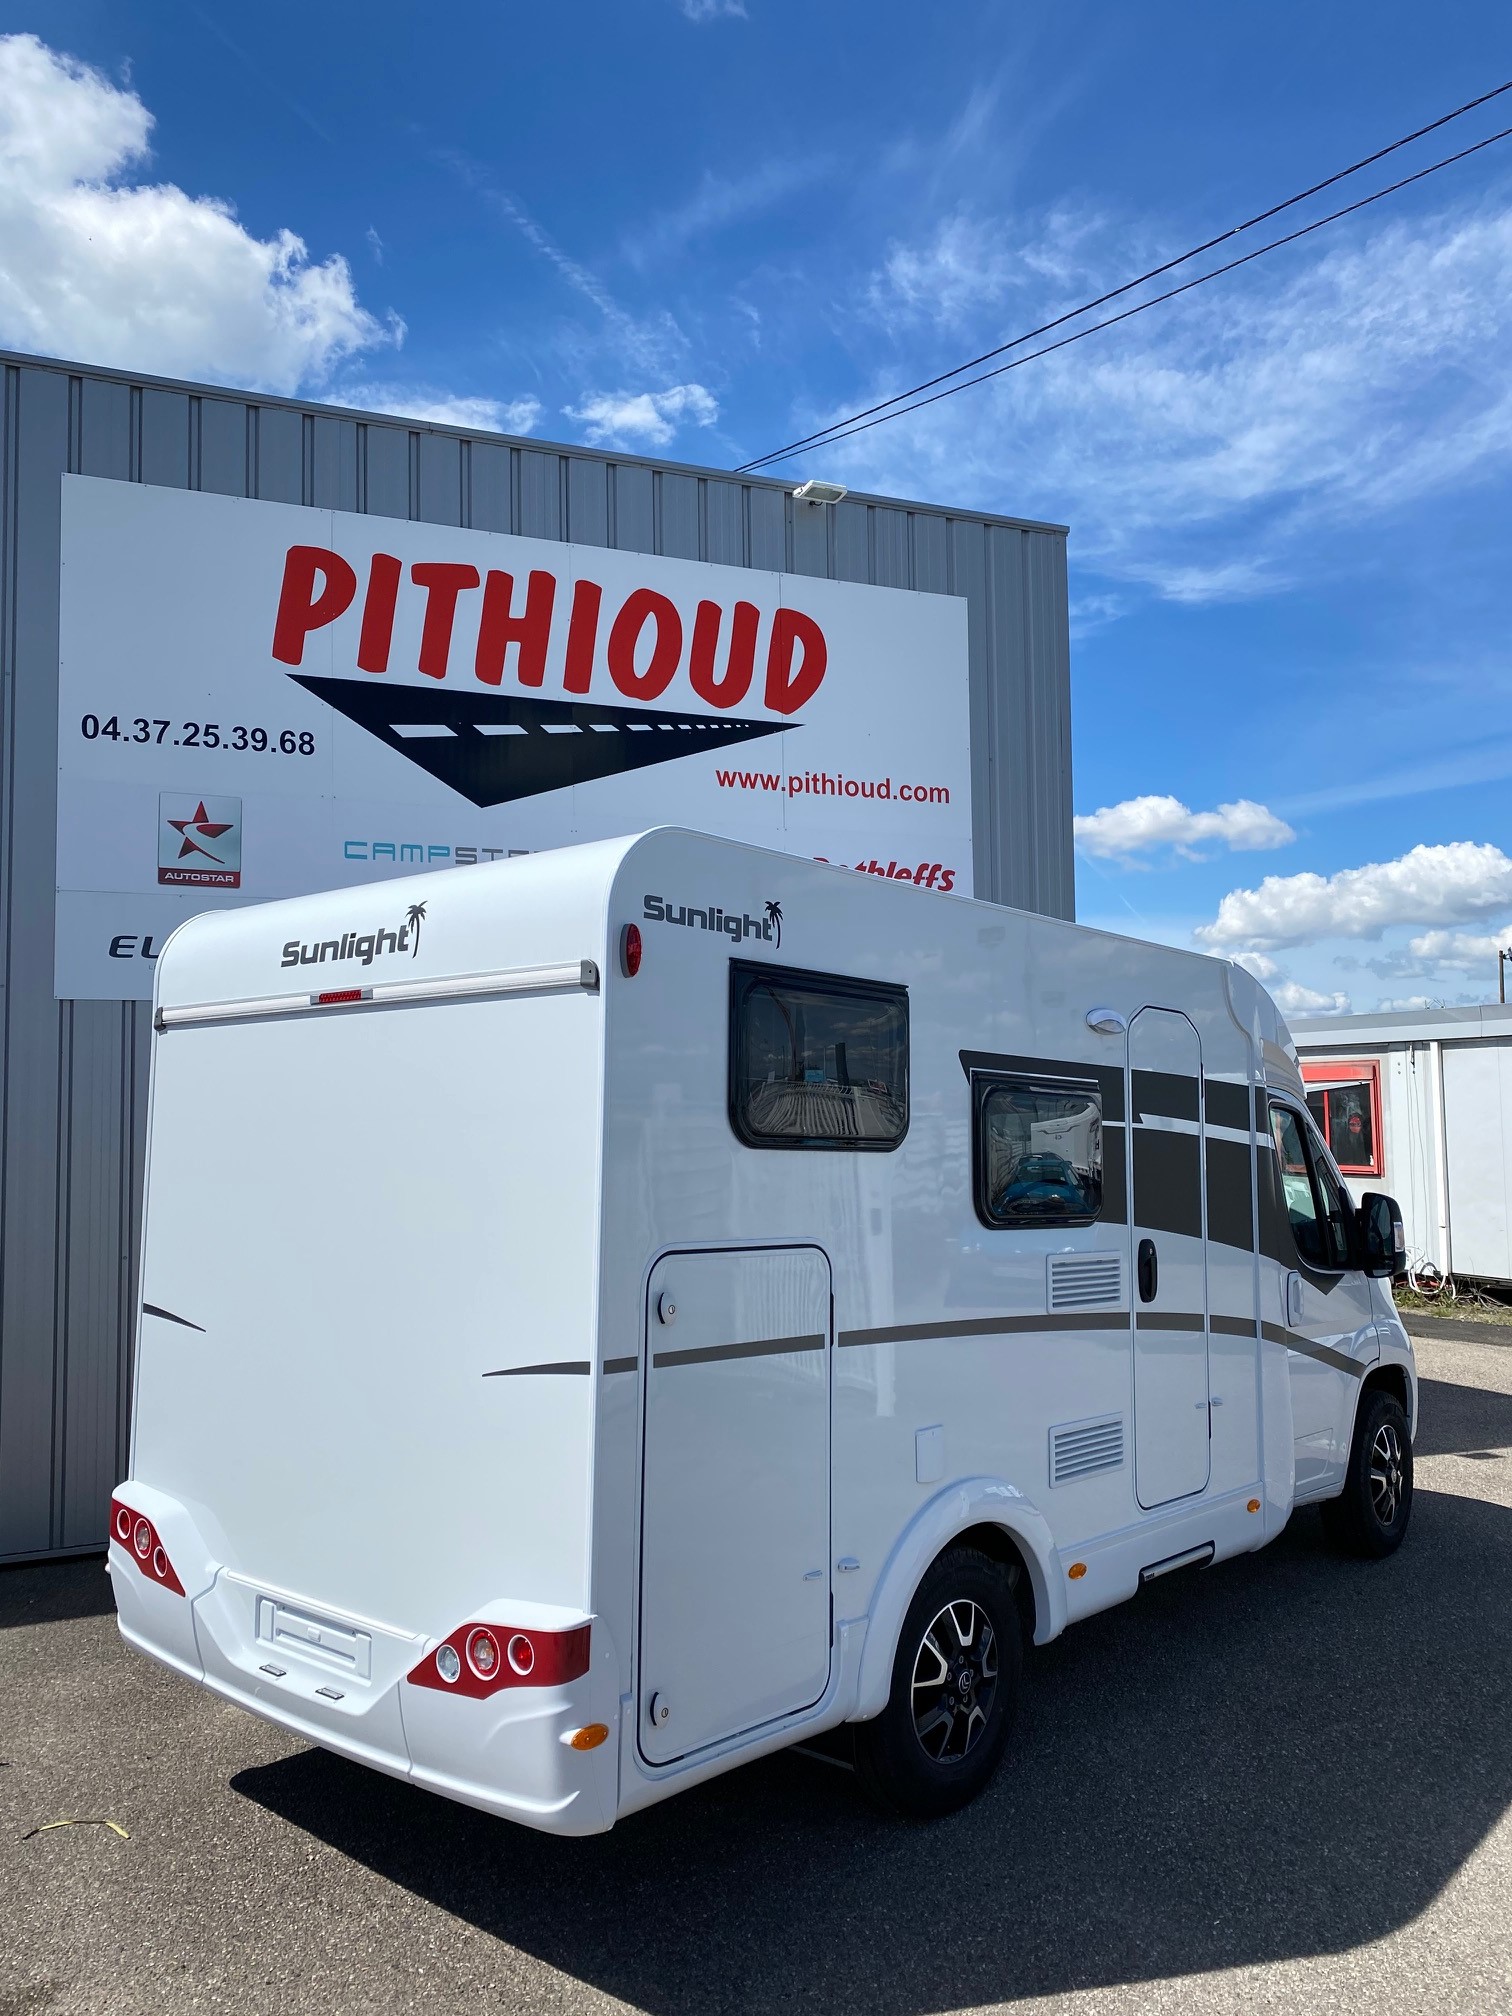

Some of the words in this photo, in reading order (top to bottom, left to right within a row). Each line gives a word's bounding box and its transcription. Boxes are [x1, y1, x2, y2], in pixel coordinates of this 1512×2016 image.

[273, 545, 828, 715] PITHIOUD
[81, 713, 316, 756] 04.37.25.39.68
[715, 769, 950, 803] www.pithioud.com
[344, 840, 542, 865] CAMPST
[164, 872, 235, 882] AUTOSTAR
[813, 857, 956, 892] hleffs
[644, 894, 773, 943] Sunlight
[281, 924, 410, 968] Sunlight
